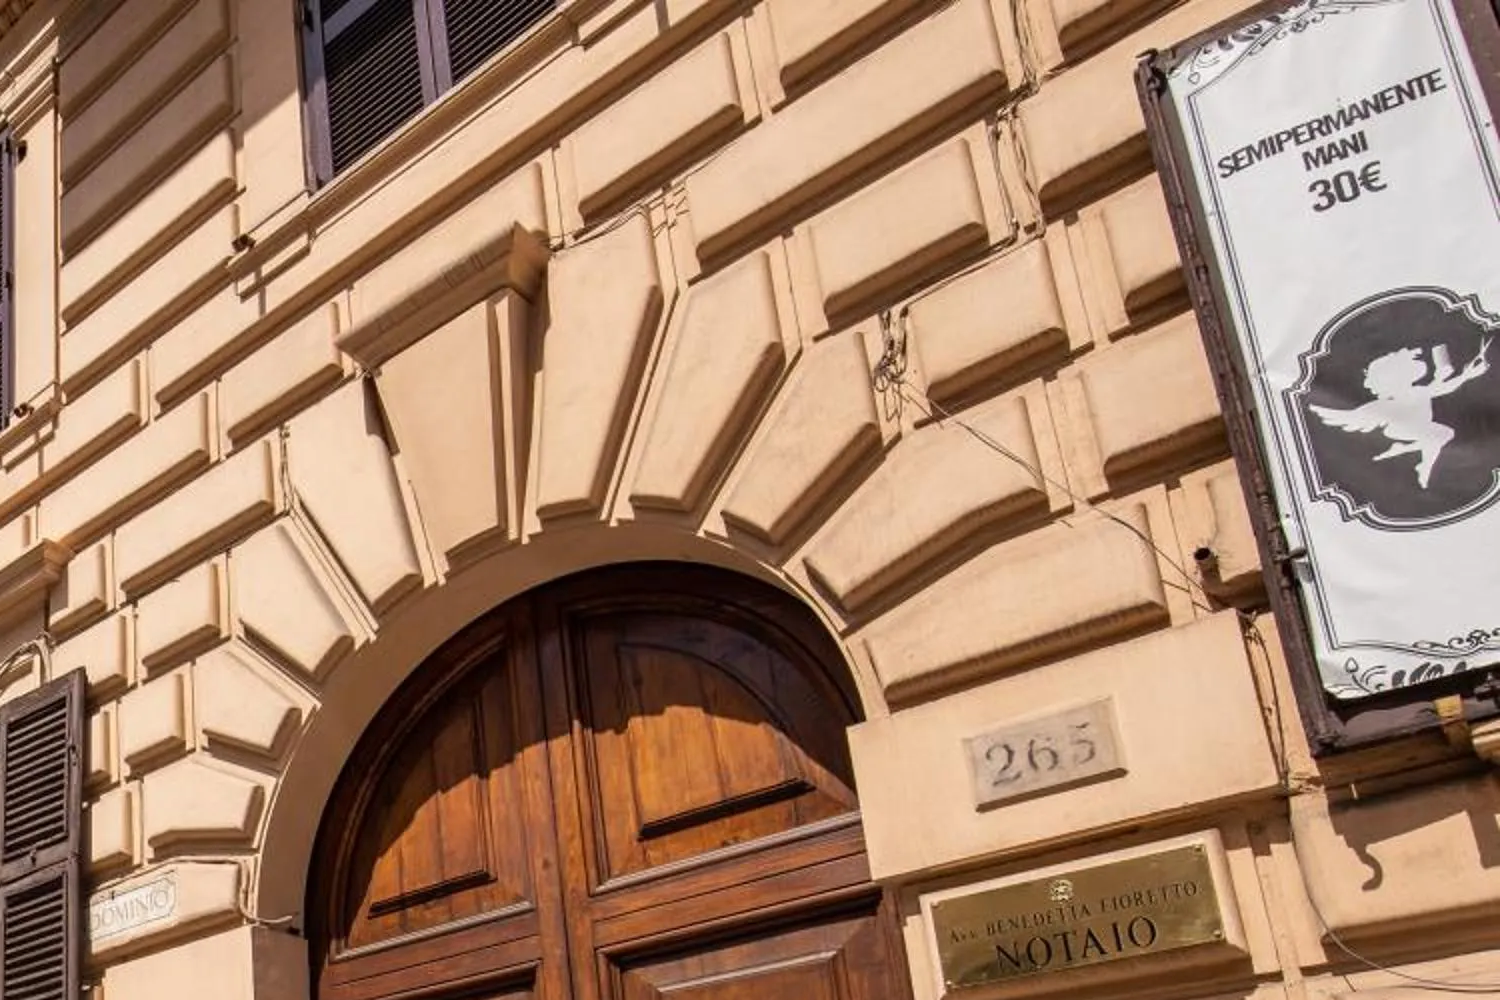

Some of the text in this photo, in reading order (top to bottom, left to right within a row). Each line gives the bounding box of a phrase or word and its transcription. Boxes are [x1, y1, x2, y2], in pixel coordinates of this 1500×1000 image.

[1217, 68, 1447, 178] SEMIPERMANENTE
[1302, 131, 1369, 171] MANI
[1308, 160, 1387, 212] 30€
[985, 721, 1096, 787] 265
[995, 915, 1157, 971] NOTAIO
